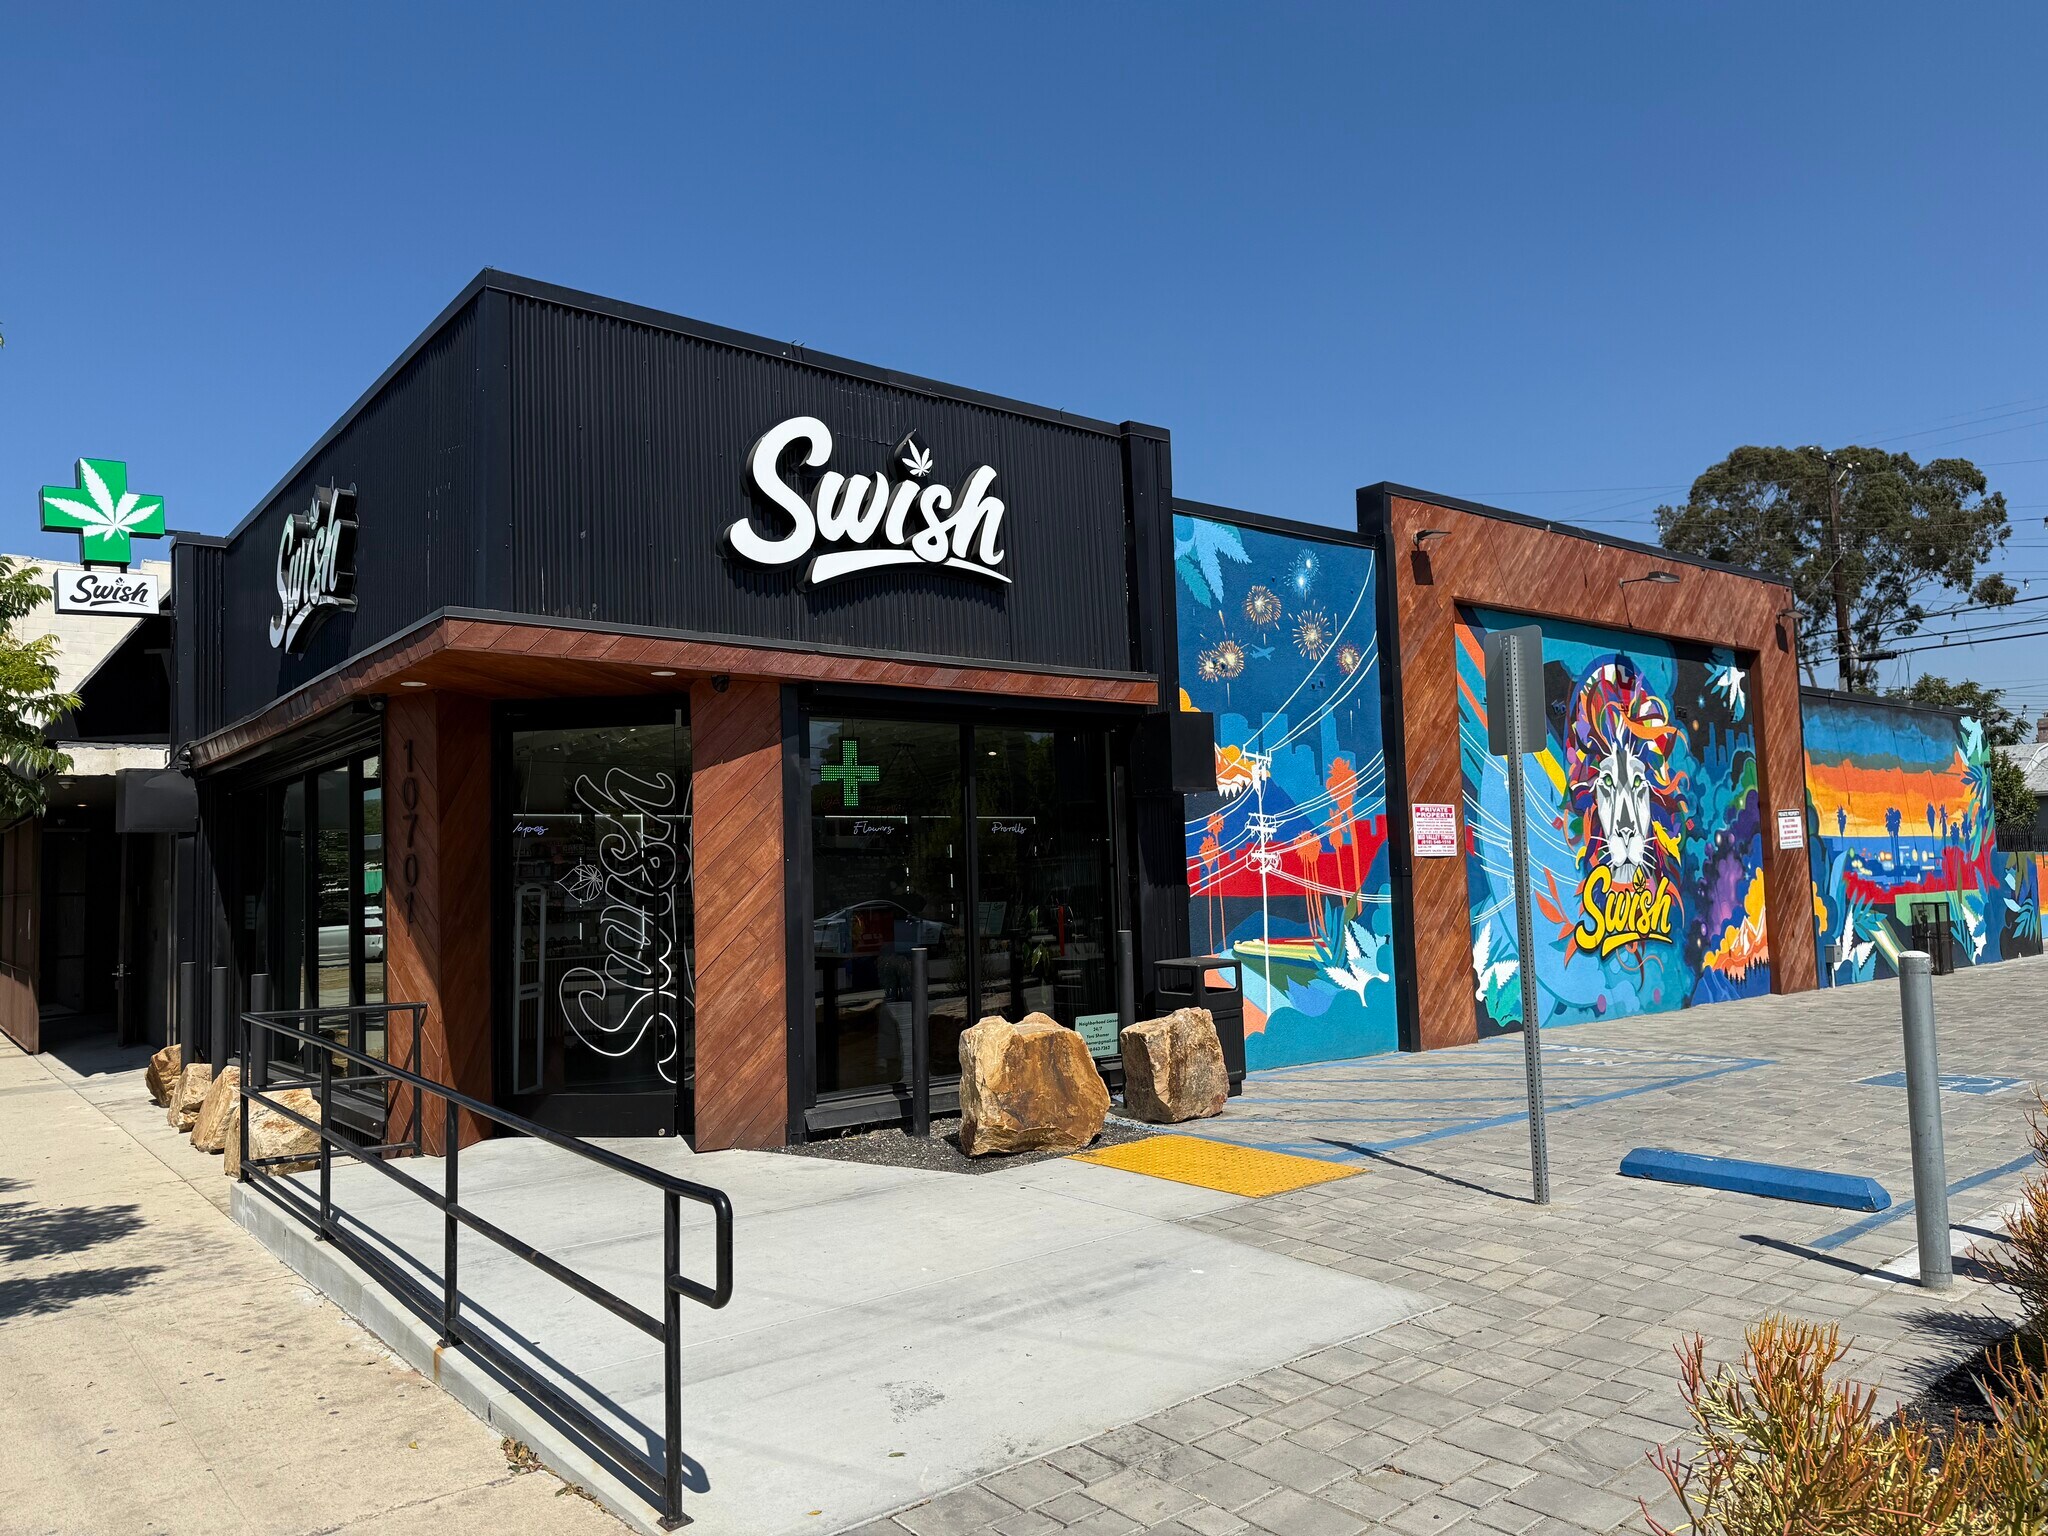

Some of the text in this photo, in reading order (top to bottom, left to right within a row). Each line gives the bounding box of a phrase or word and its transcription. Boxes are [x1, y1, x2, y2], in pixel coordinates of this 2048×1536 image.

[268, 488, 343, 654] Swish
[730, 416, 1012, 584] Swish
[69, 575, 149, 607] Swish
[402, 738, 419, 923] 10701
[1574, 864, 1674, 960] Swish
[559, 768, 691, 1083] Swish
